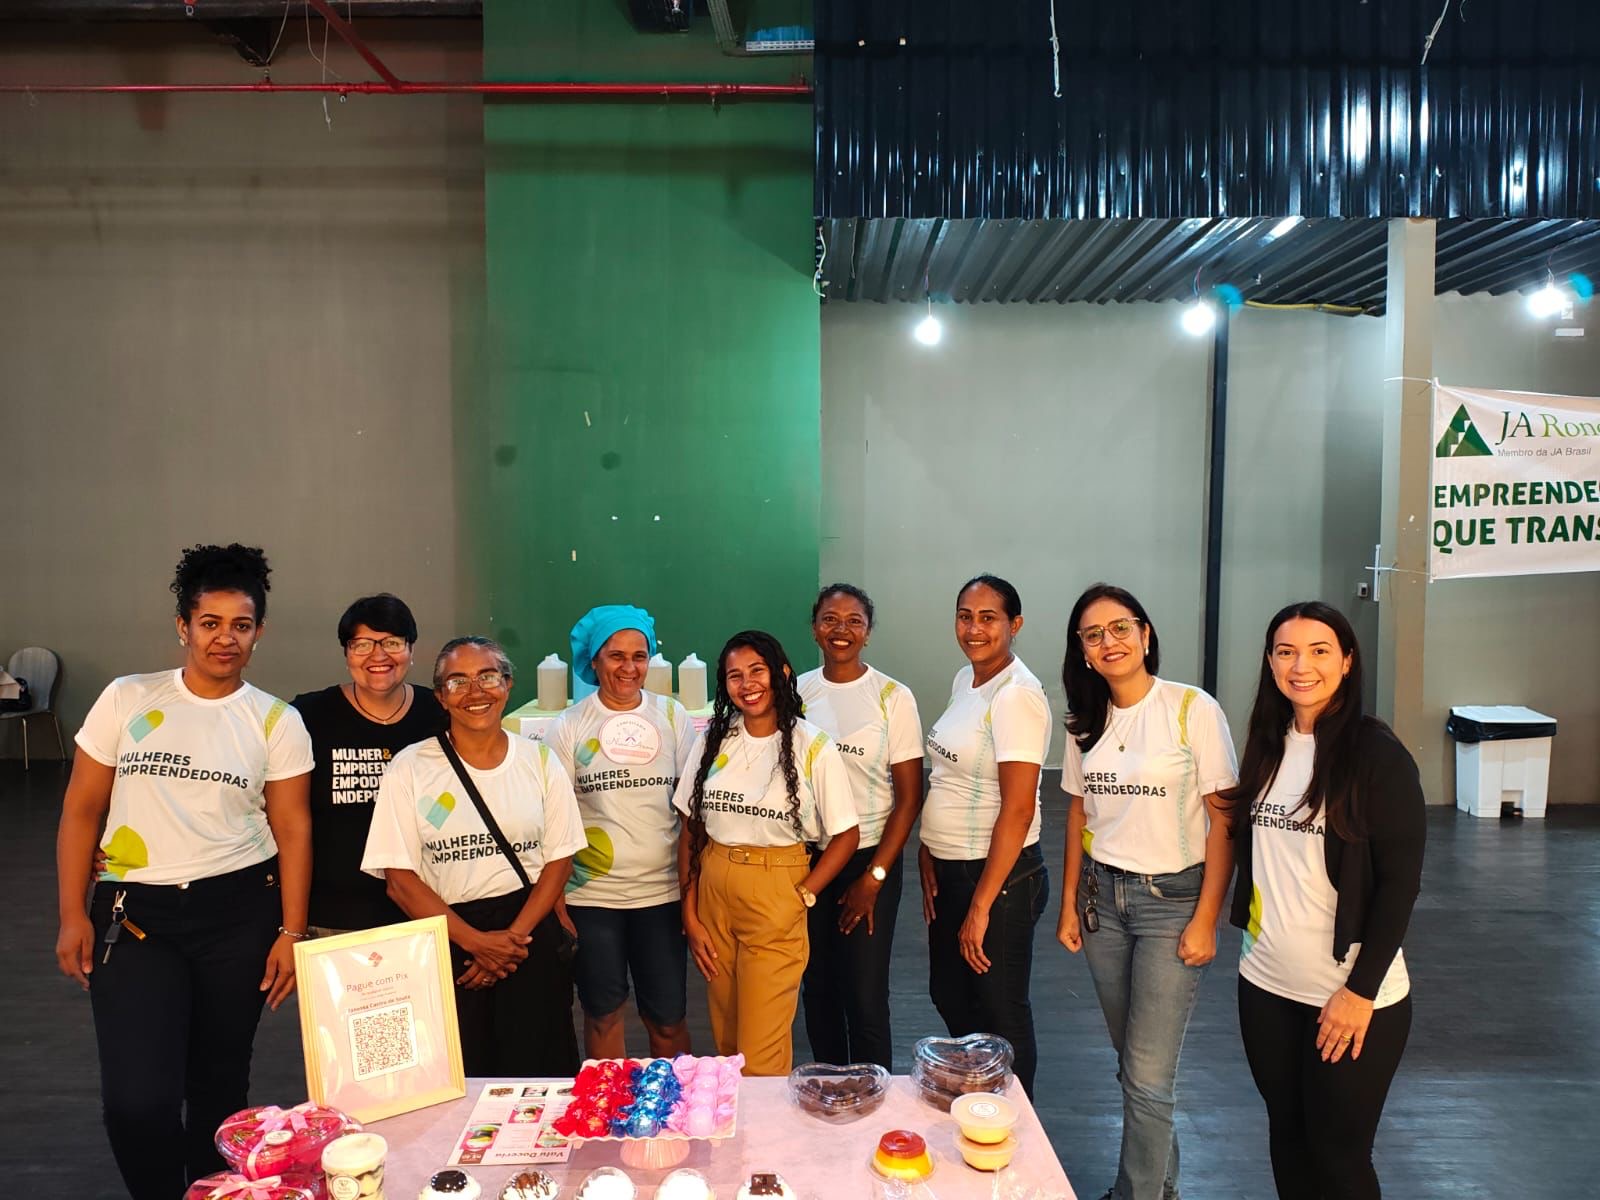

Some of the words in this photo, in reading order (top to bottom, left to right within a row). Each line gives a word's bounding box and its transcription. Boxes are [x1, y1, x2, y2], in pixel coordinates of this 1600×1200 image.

[1494, 411, 1535, 445] JA
[1497, 448, 1533, 457] Membro
[1536, 448, 1548, 457] da
[1551, 447, 1562, 457] JA
[1565, 447, 1592, 456] Brasil
[1434, 480, 1600, 508] EMPREENDE
[1433, 518, 1496, 554] QUE
[119, 751, 192, 766] MULHERES
[118, 764, 249, 789] EMPREENDEDORAS
[576, 768, 631, 785] MULHERES
[1084, 772, 1117, 783] HERES
[1250, 801, 1286, 816] HERES
[346, 981, 373, 993] Pague
[375, 976, 394, 986] com
[395, 973, 409, 981] Pix
